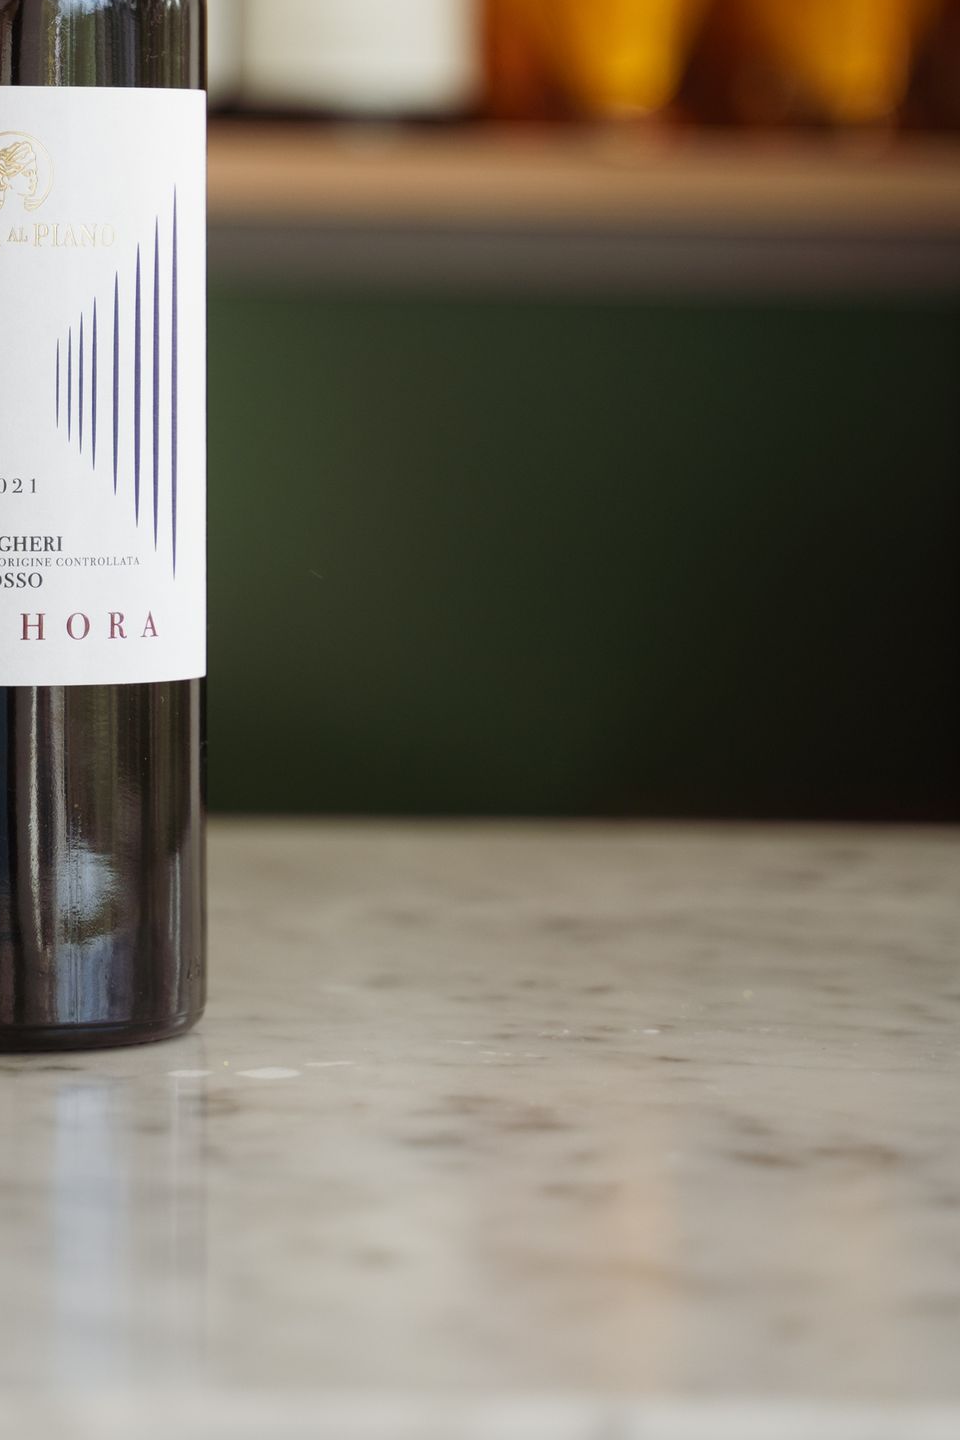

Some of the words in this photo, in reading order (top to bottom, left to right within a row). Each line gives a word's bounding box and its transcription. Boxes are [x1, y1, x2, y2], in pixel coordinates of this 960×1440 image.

[33, 223, 115, 247] PIANO
[55, 555, 141, 567] CONTROLLATA
[20, 610, 160, 641] HORA
